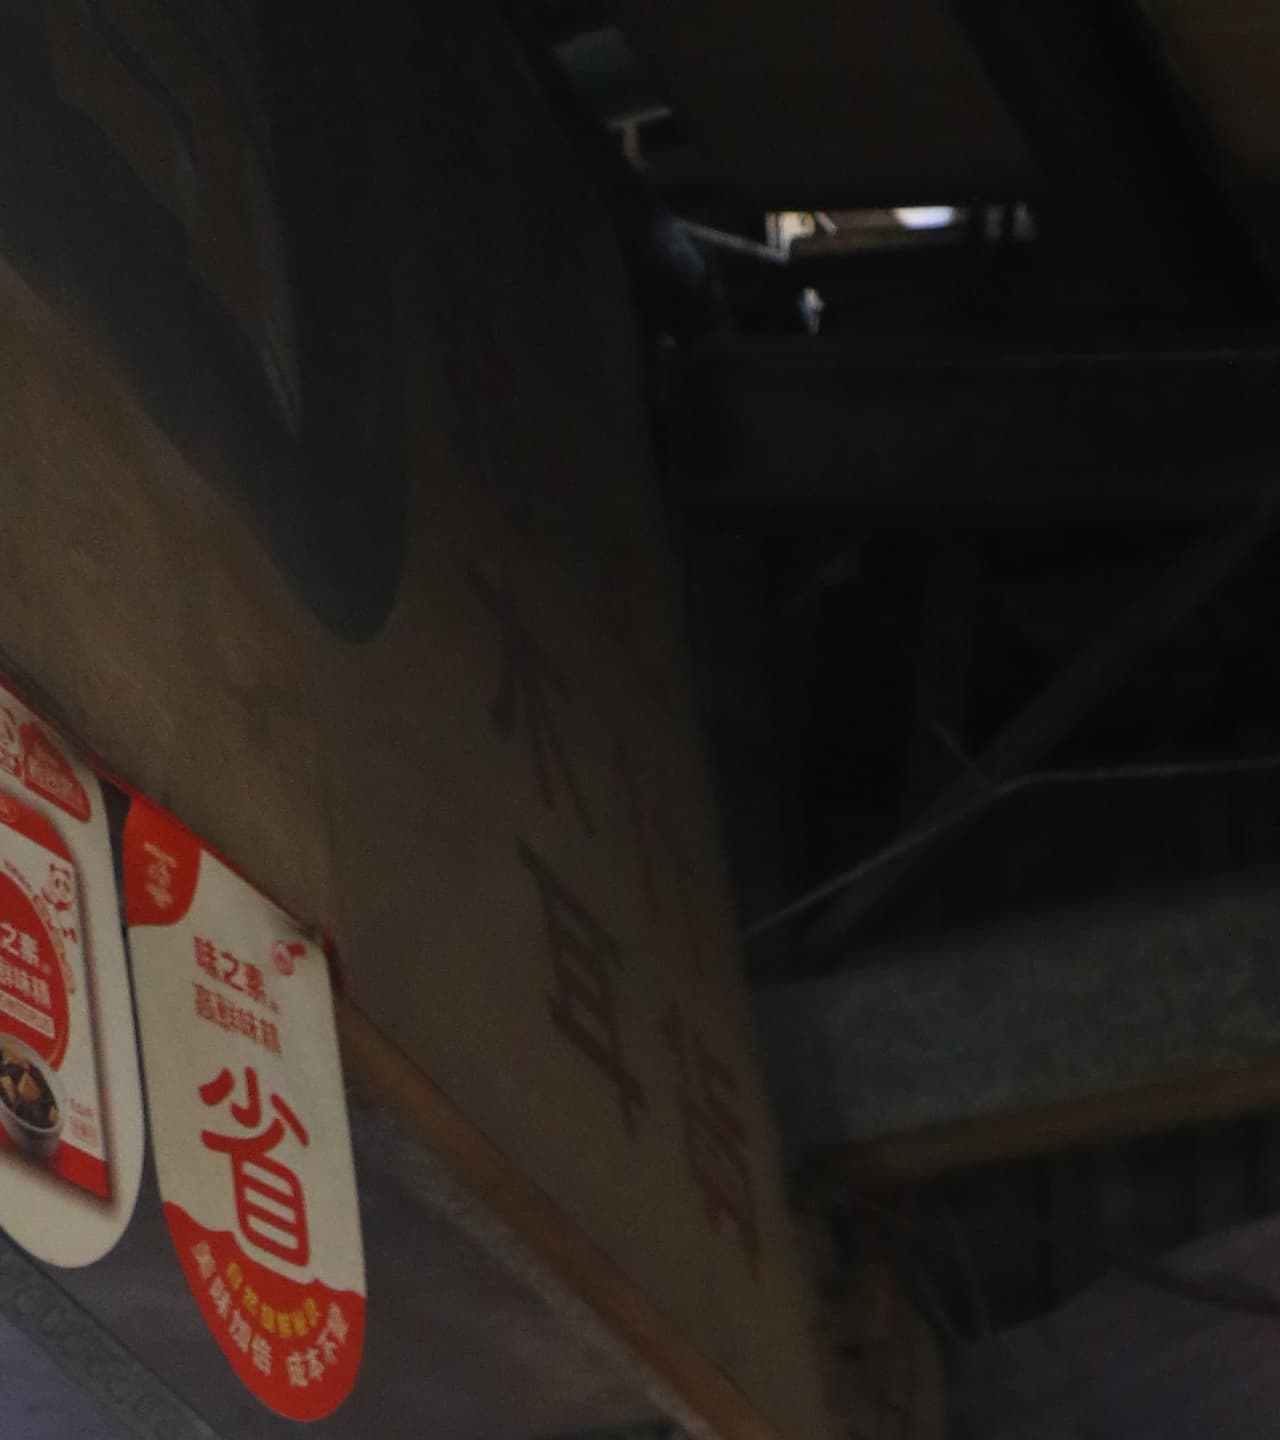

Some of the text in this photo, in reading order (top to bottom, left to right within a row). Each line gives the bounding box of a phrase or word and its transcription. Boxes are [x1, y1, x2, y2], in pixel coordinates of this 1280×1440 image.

[193, 935, 266, 1004] 味之素
[193, 981, 282, 1056] 高鮮味精
[198, 1066, 311, 1267] 省
